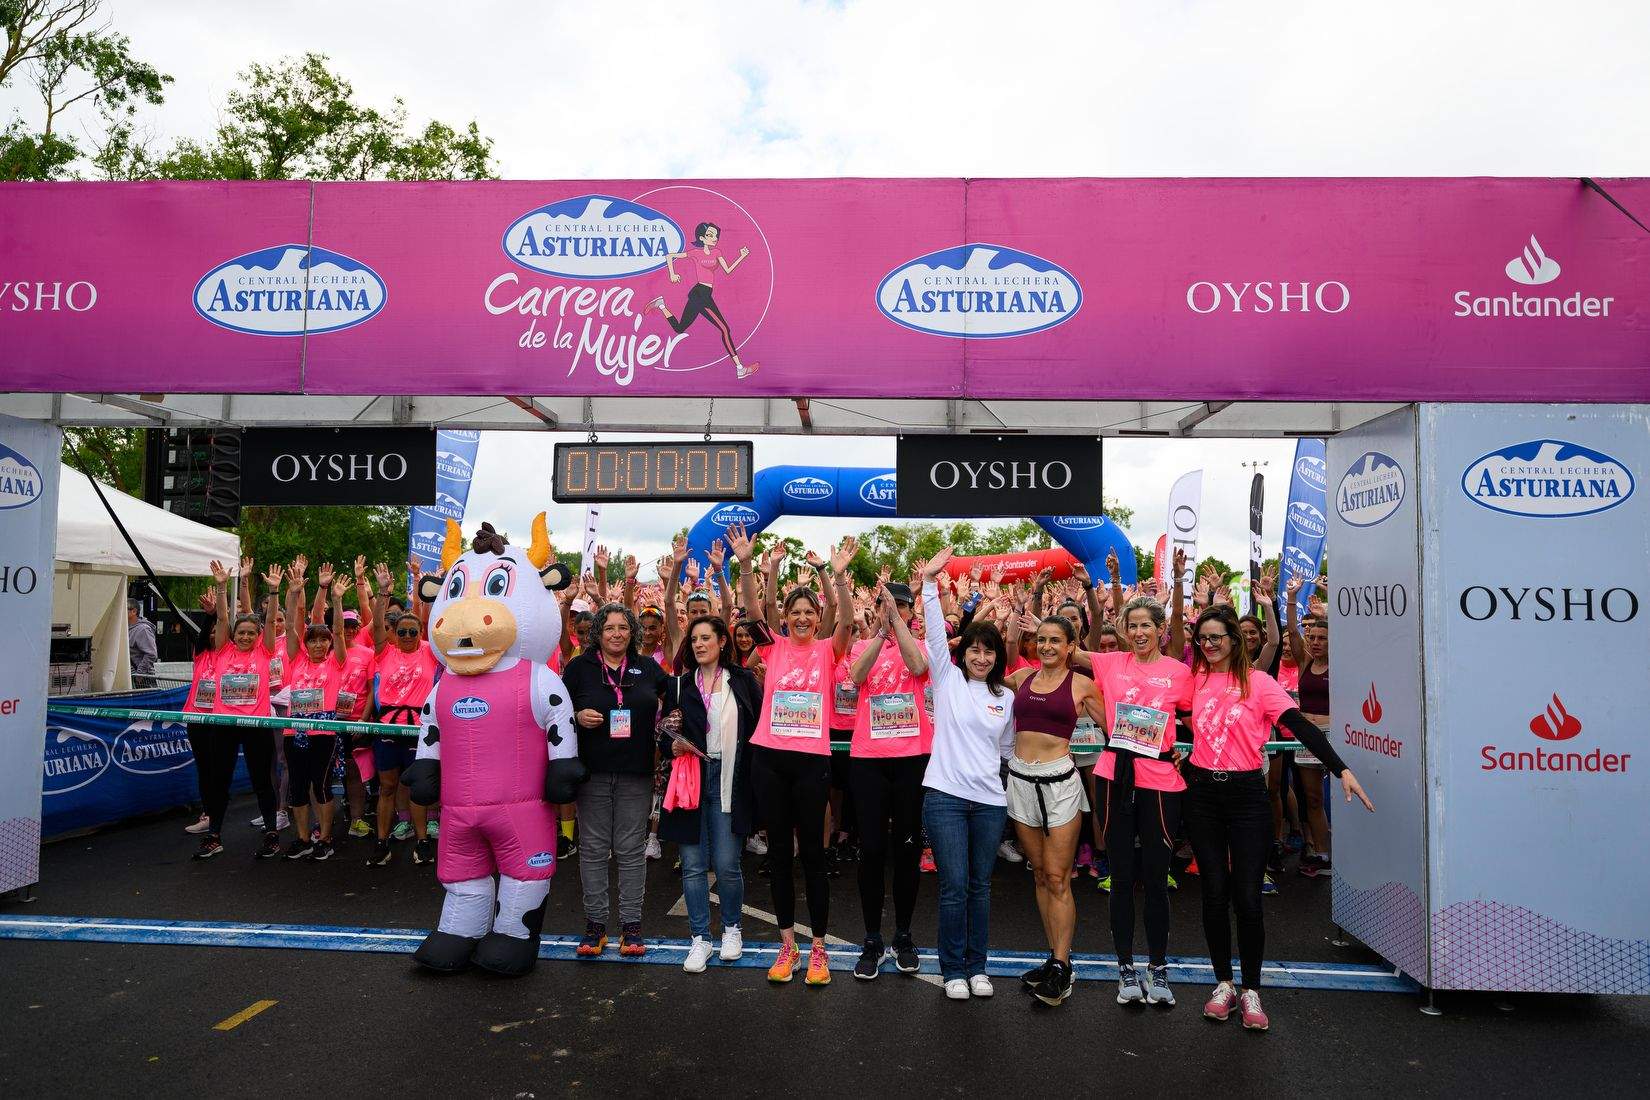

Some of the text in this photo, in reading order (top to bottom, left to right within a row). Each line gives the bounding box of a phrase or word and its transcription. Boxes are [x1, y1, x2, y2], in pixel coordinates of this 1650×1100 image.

[515, 225, 673, 258] ASTURIANA
[545, 224, 666, 233] CENTRAL LECHERA
[206, 278, 372, 313] ASTURIANA
[238, 276, 297, 286] CENTRAL
[483, 272, 634, 318] Carrera
[891, 278, 1067, 314] ASTURIANA
[923, 276, 1060, 286] CENTRAL LECHERA
[1186, 280, 1351, 314] OYSHO
[1454, 290, 1615, 318] Santander
[518, 318, 573, 350] de la
[566, 313, 690, 386] Mujer
[271, 452, 408, 483] OYSHO
[929, 460, 1072, 490] OYSHO
[1500, 465, 1615, 476] CENTRAL LECHERA
[787, 485, 830, 495] ASTURIANA
[1340, 483, 1401, 514] ASTURIANA
[1474, 468, 1622, 499] ASTURIANA
[715, 513, 756, 523] ASTURIANA
[1058, 515, 1100, 525] ASTURIANA
[1337, 583, 1407, 618] OYSHO
[1460, 585, 1639, 623] OYSHO
[453, 705, 487, 714] ASTURIANA
[120, 739, 193, 764] ASTURIAN
[1344, 723, 1403, 759] Santander
[1481, 745, 1632, 773] Santander
